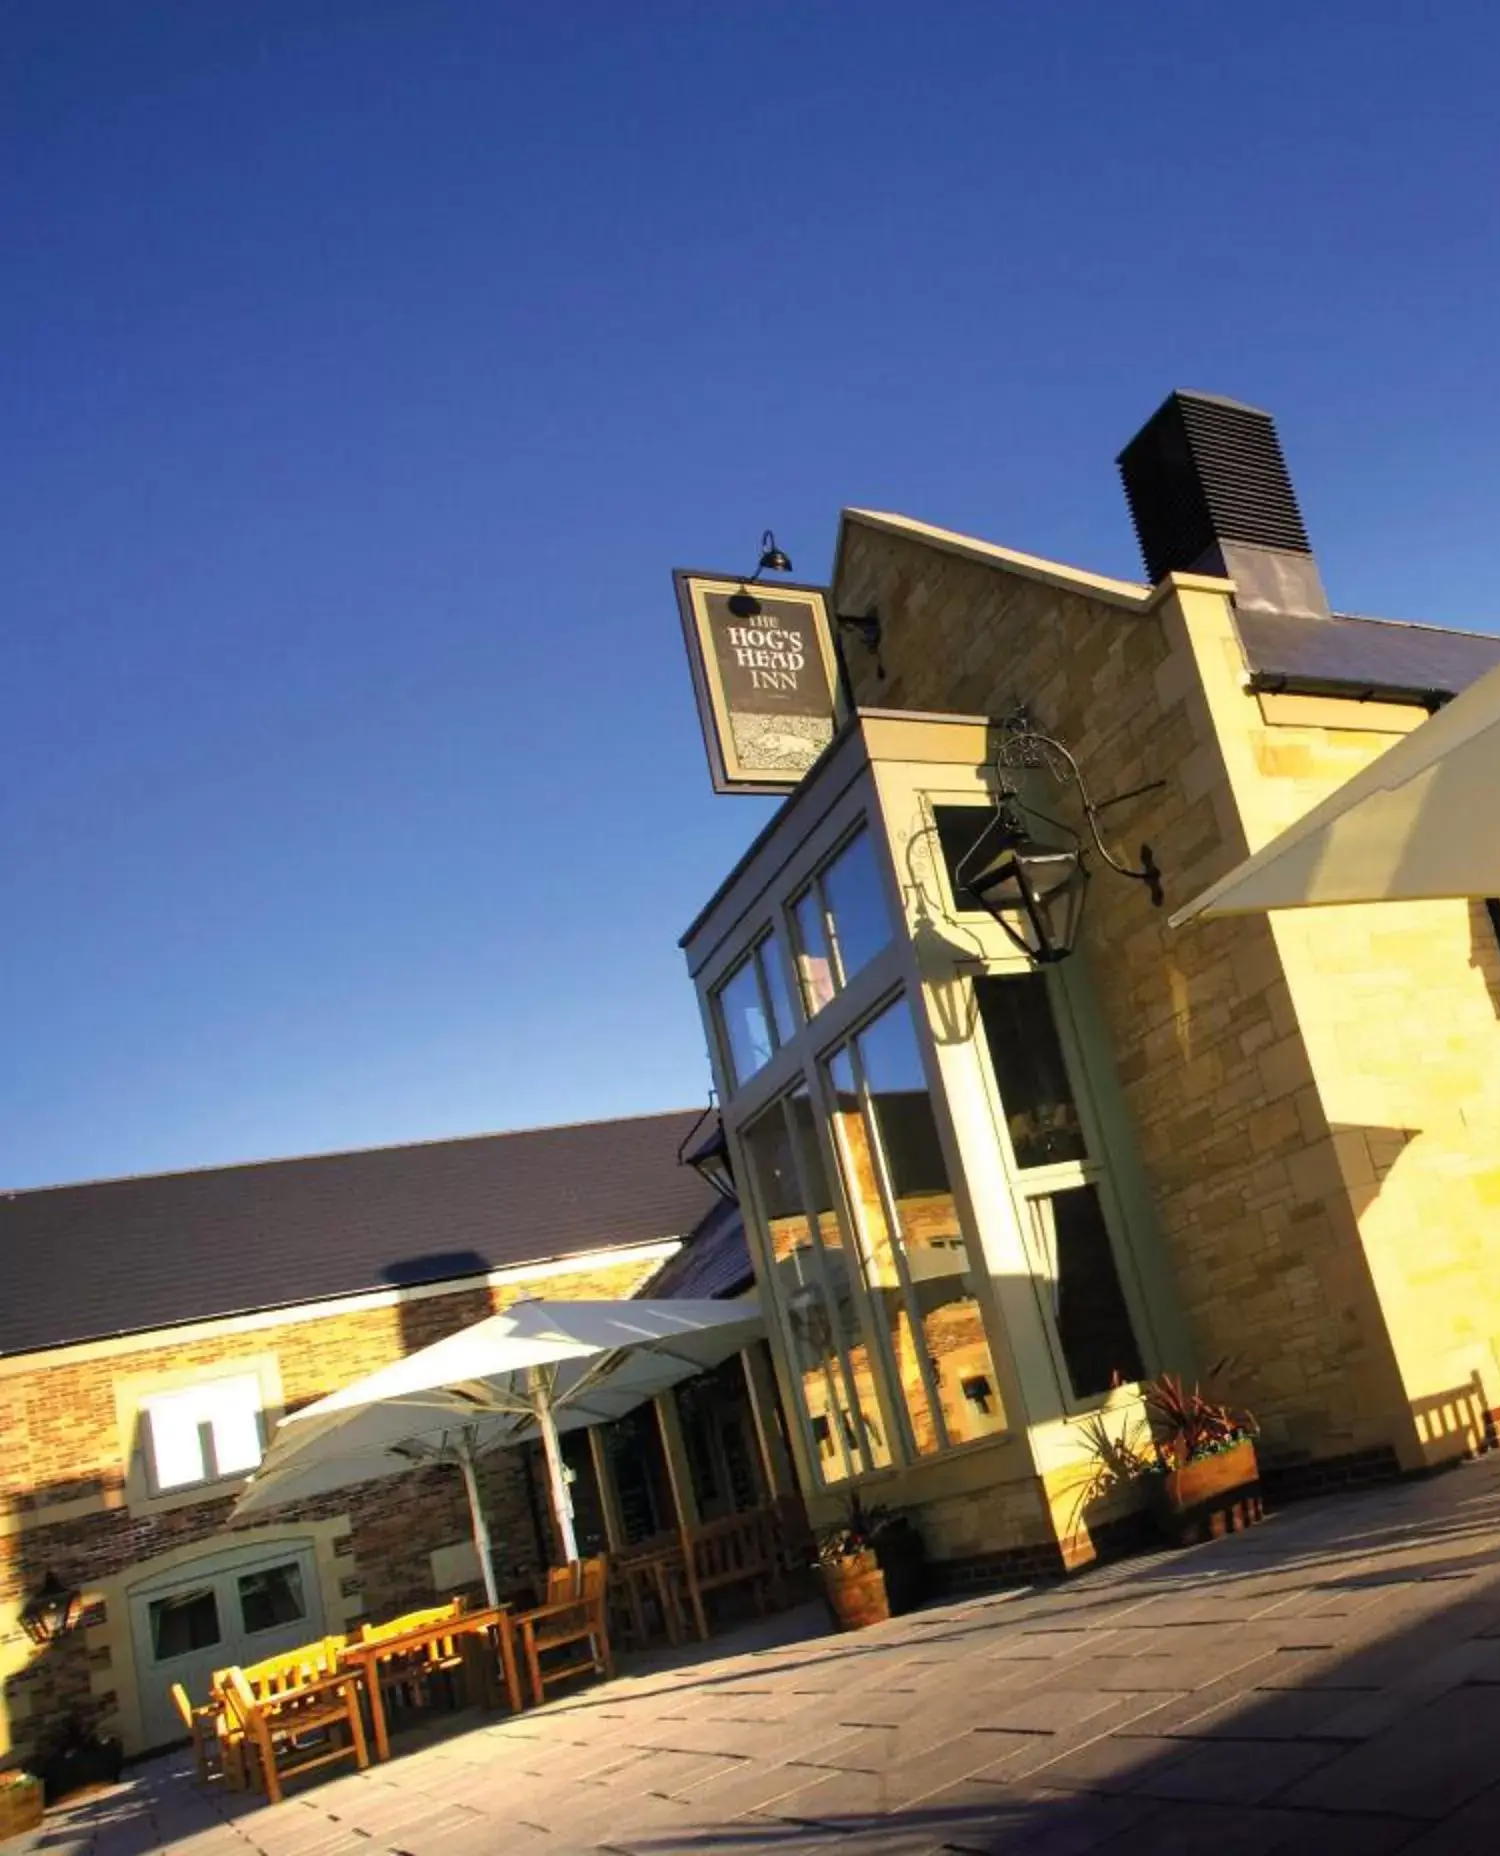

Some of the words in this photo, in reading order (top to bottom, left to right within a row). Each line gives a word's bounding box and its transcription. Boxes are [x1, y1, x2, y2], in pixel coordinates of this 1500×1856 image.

[728, 627, 803, 652] HOG'S
[736, 648, 804, 670] HEAD
[750, 670, 798, 690] INN
